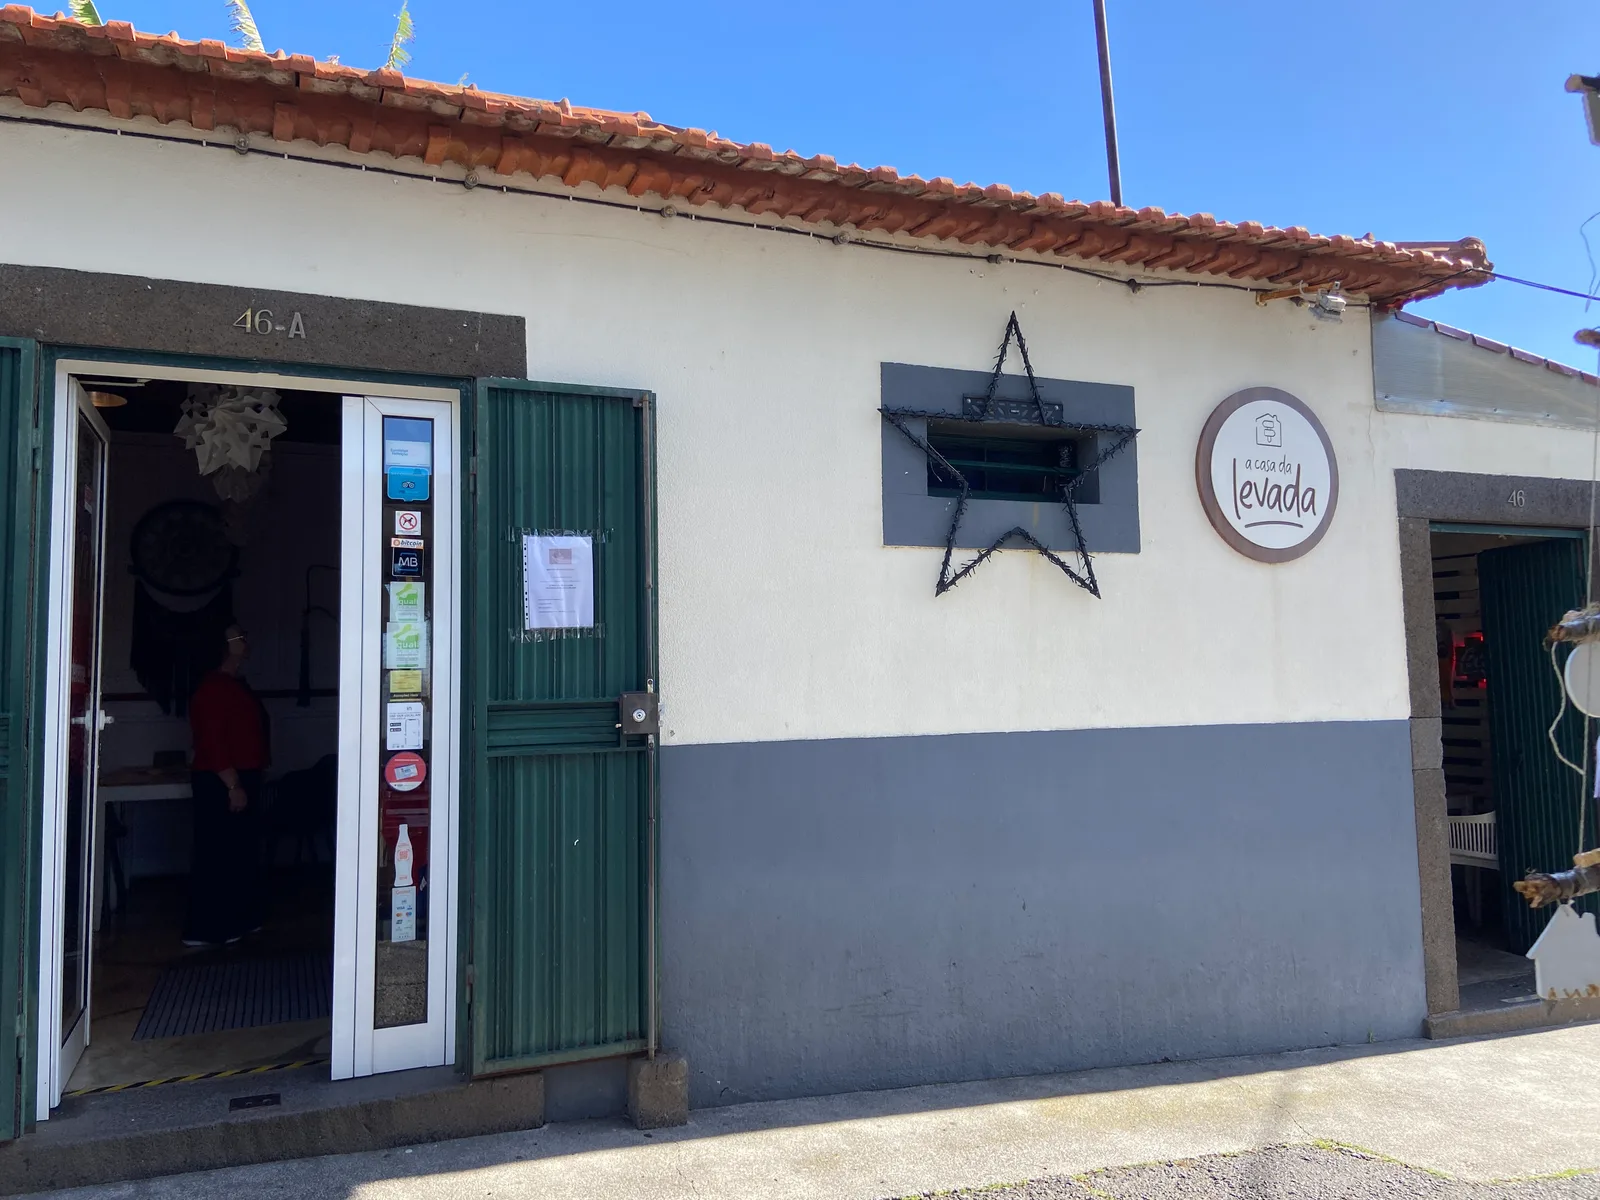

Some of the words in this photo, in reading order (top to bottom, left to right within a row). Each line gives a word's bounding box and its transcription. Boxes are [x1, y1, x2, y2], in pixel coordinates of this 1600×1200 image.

[232, 307, 306, 339] 46-A
[1245, 458, 1252, 470] a
[1255, 459, 1276, 473] casa
[1278, 454, 1292, 475] da
[1232, 457, 1317, 520] levada
[1507, 489, 1525, 508] 46
[400, 539, 422, 547] bitcoin
[398, 556, 418, 567] MB
